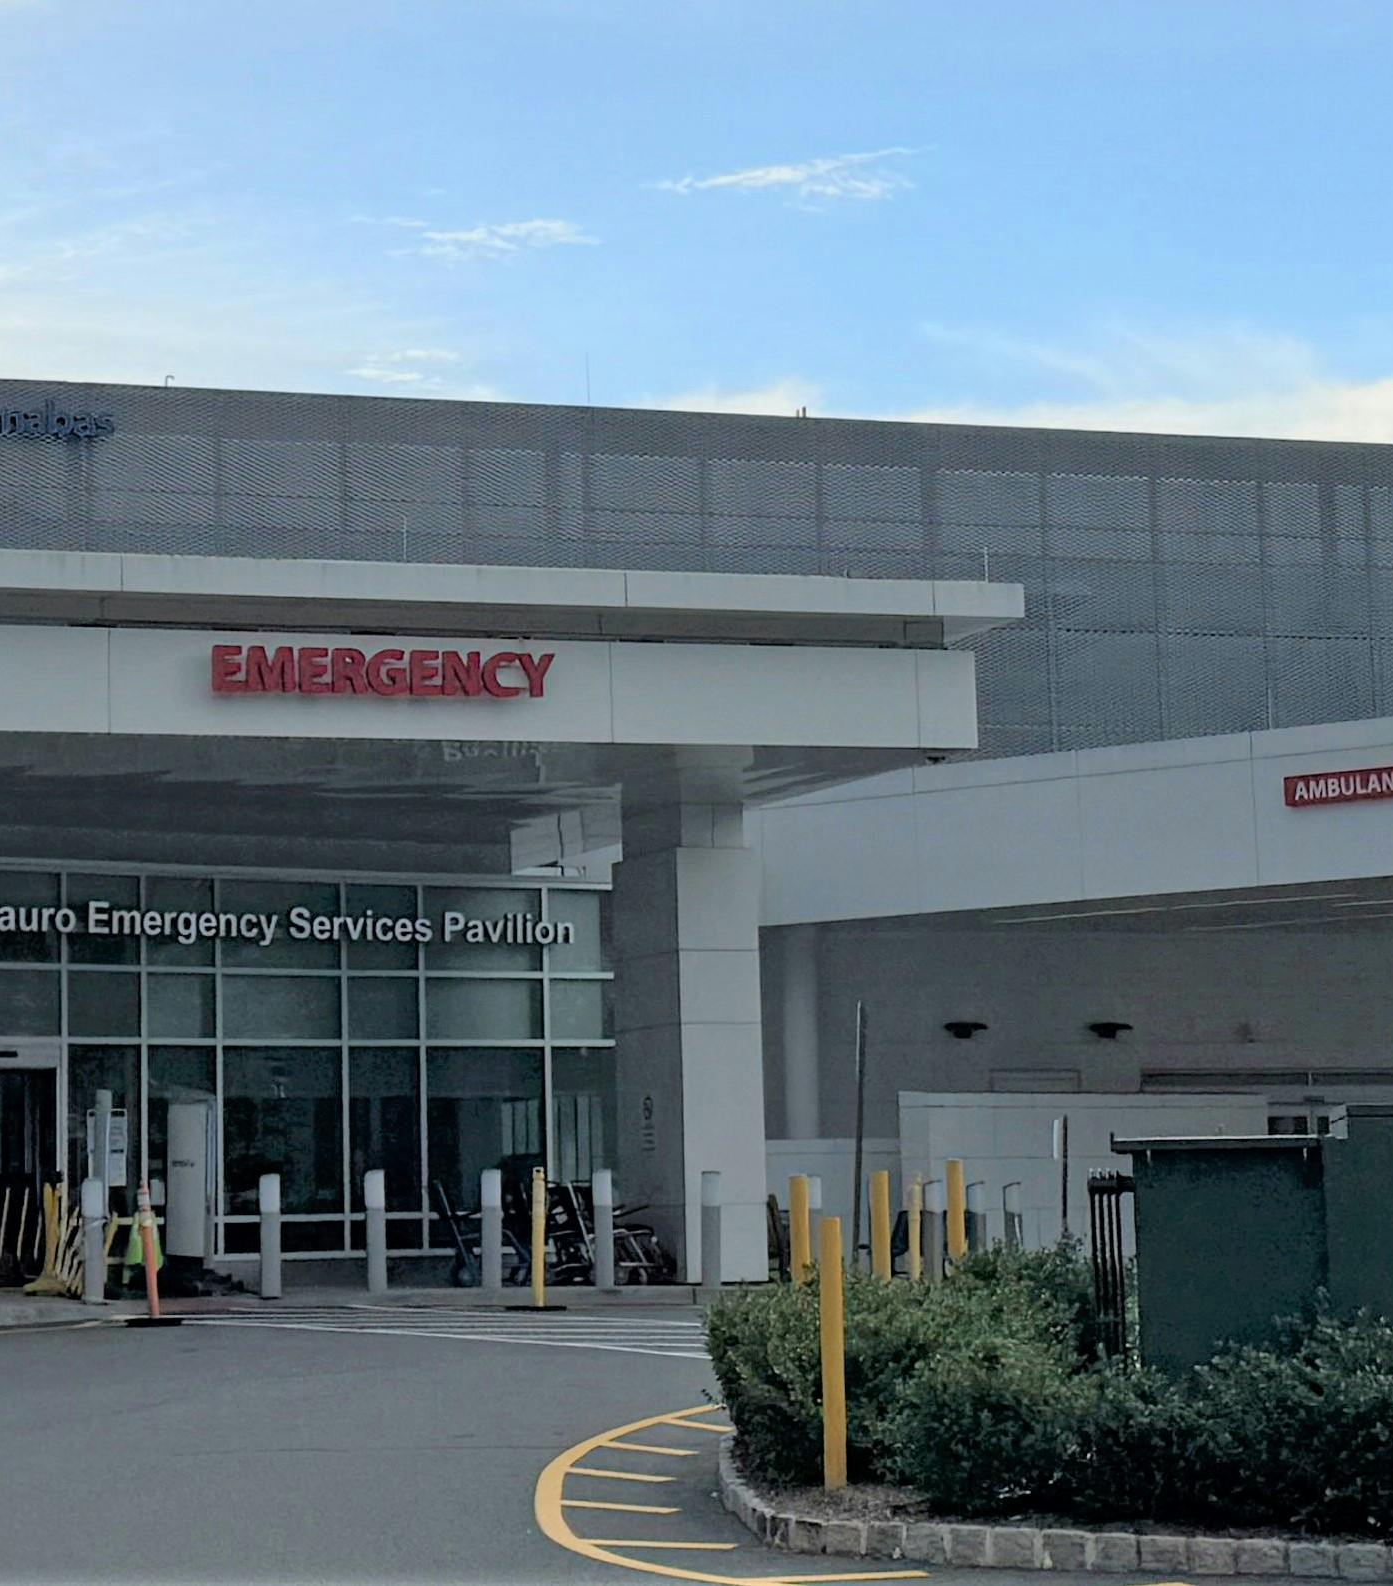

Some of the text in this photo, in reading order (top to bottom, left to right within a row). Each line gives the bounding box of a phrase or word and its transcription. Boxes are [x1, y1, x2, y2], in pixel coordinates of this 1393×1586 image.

[211, 644, 556, 699] EMERGENCY
[87, 901, 278, 947] Emergency
[289, 907, 433, 943] Services
[443, 911, 575, 945] Pavilion
